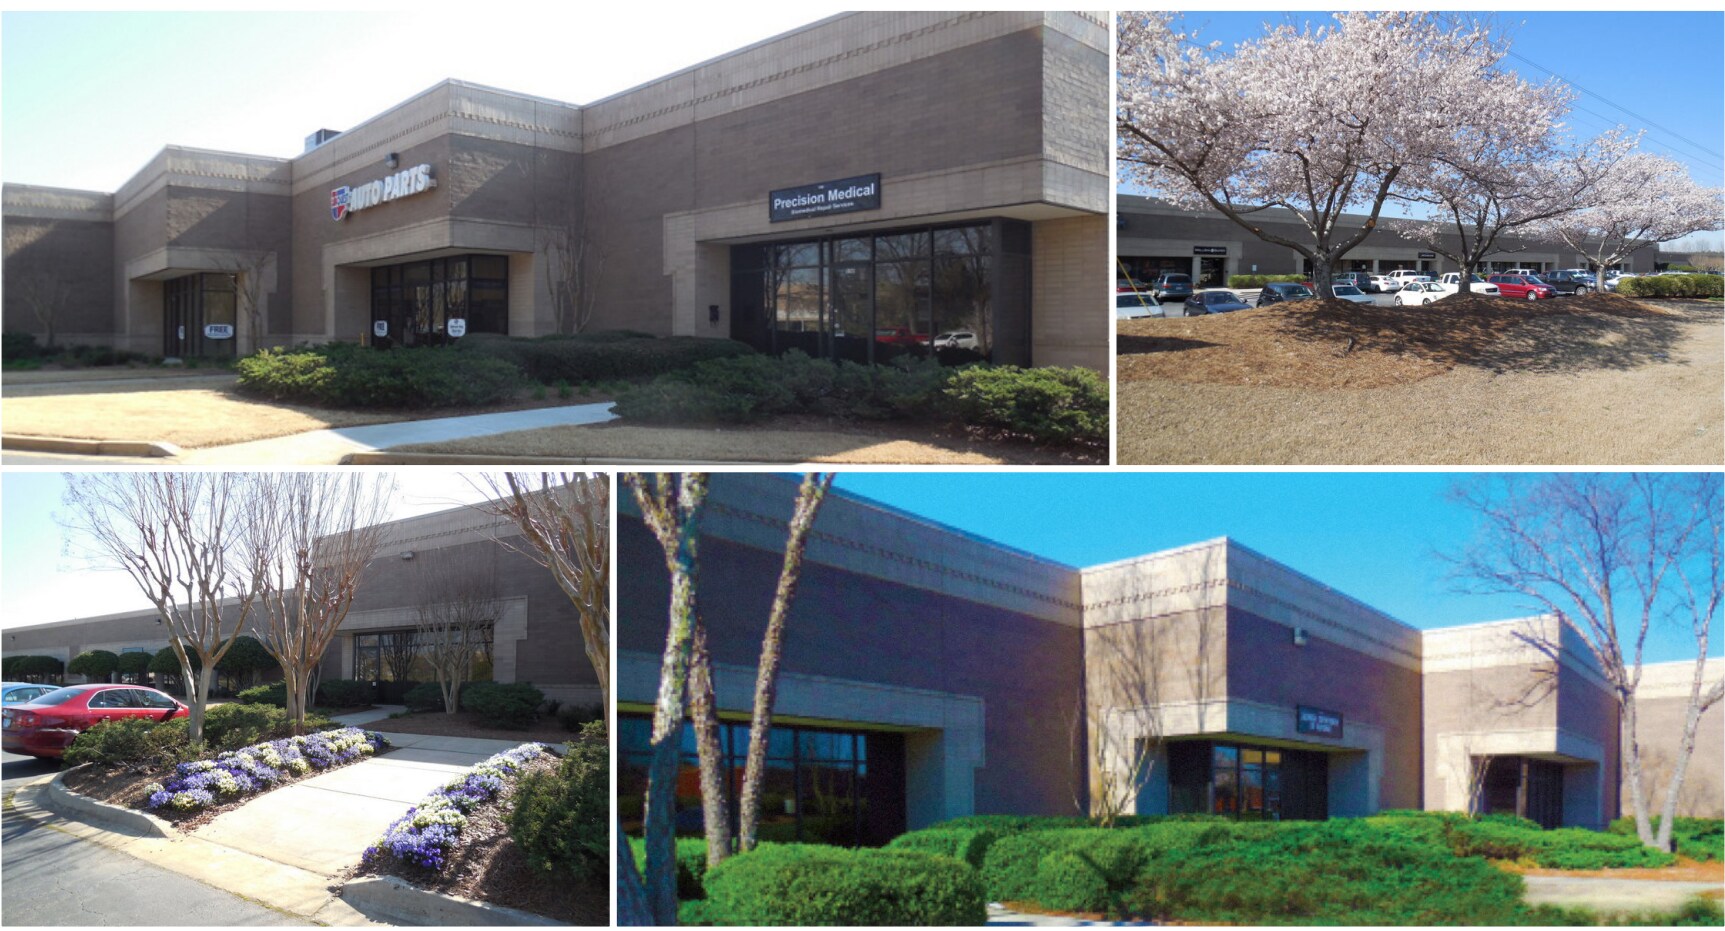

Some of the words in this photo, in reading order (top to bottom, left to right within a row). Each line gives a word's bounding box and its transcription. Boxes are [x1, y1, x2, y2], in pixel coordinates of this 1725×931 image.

[348, 180, 383, 212] AUTO
[383, 164, 431, 202] PARTS
[773, 193, 824, 210] Precision
[828, 183, 875, 201] Medical
[209, 325, 229, 334] FREE
